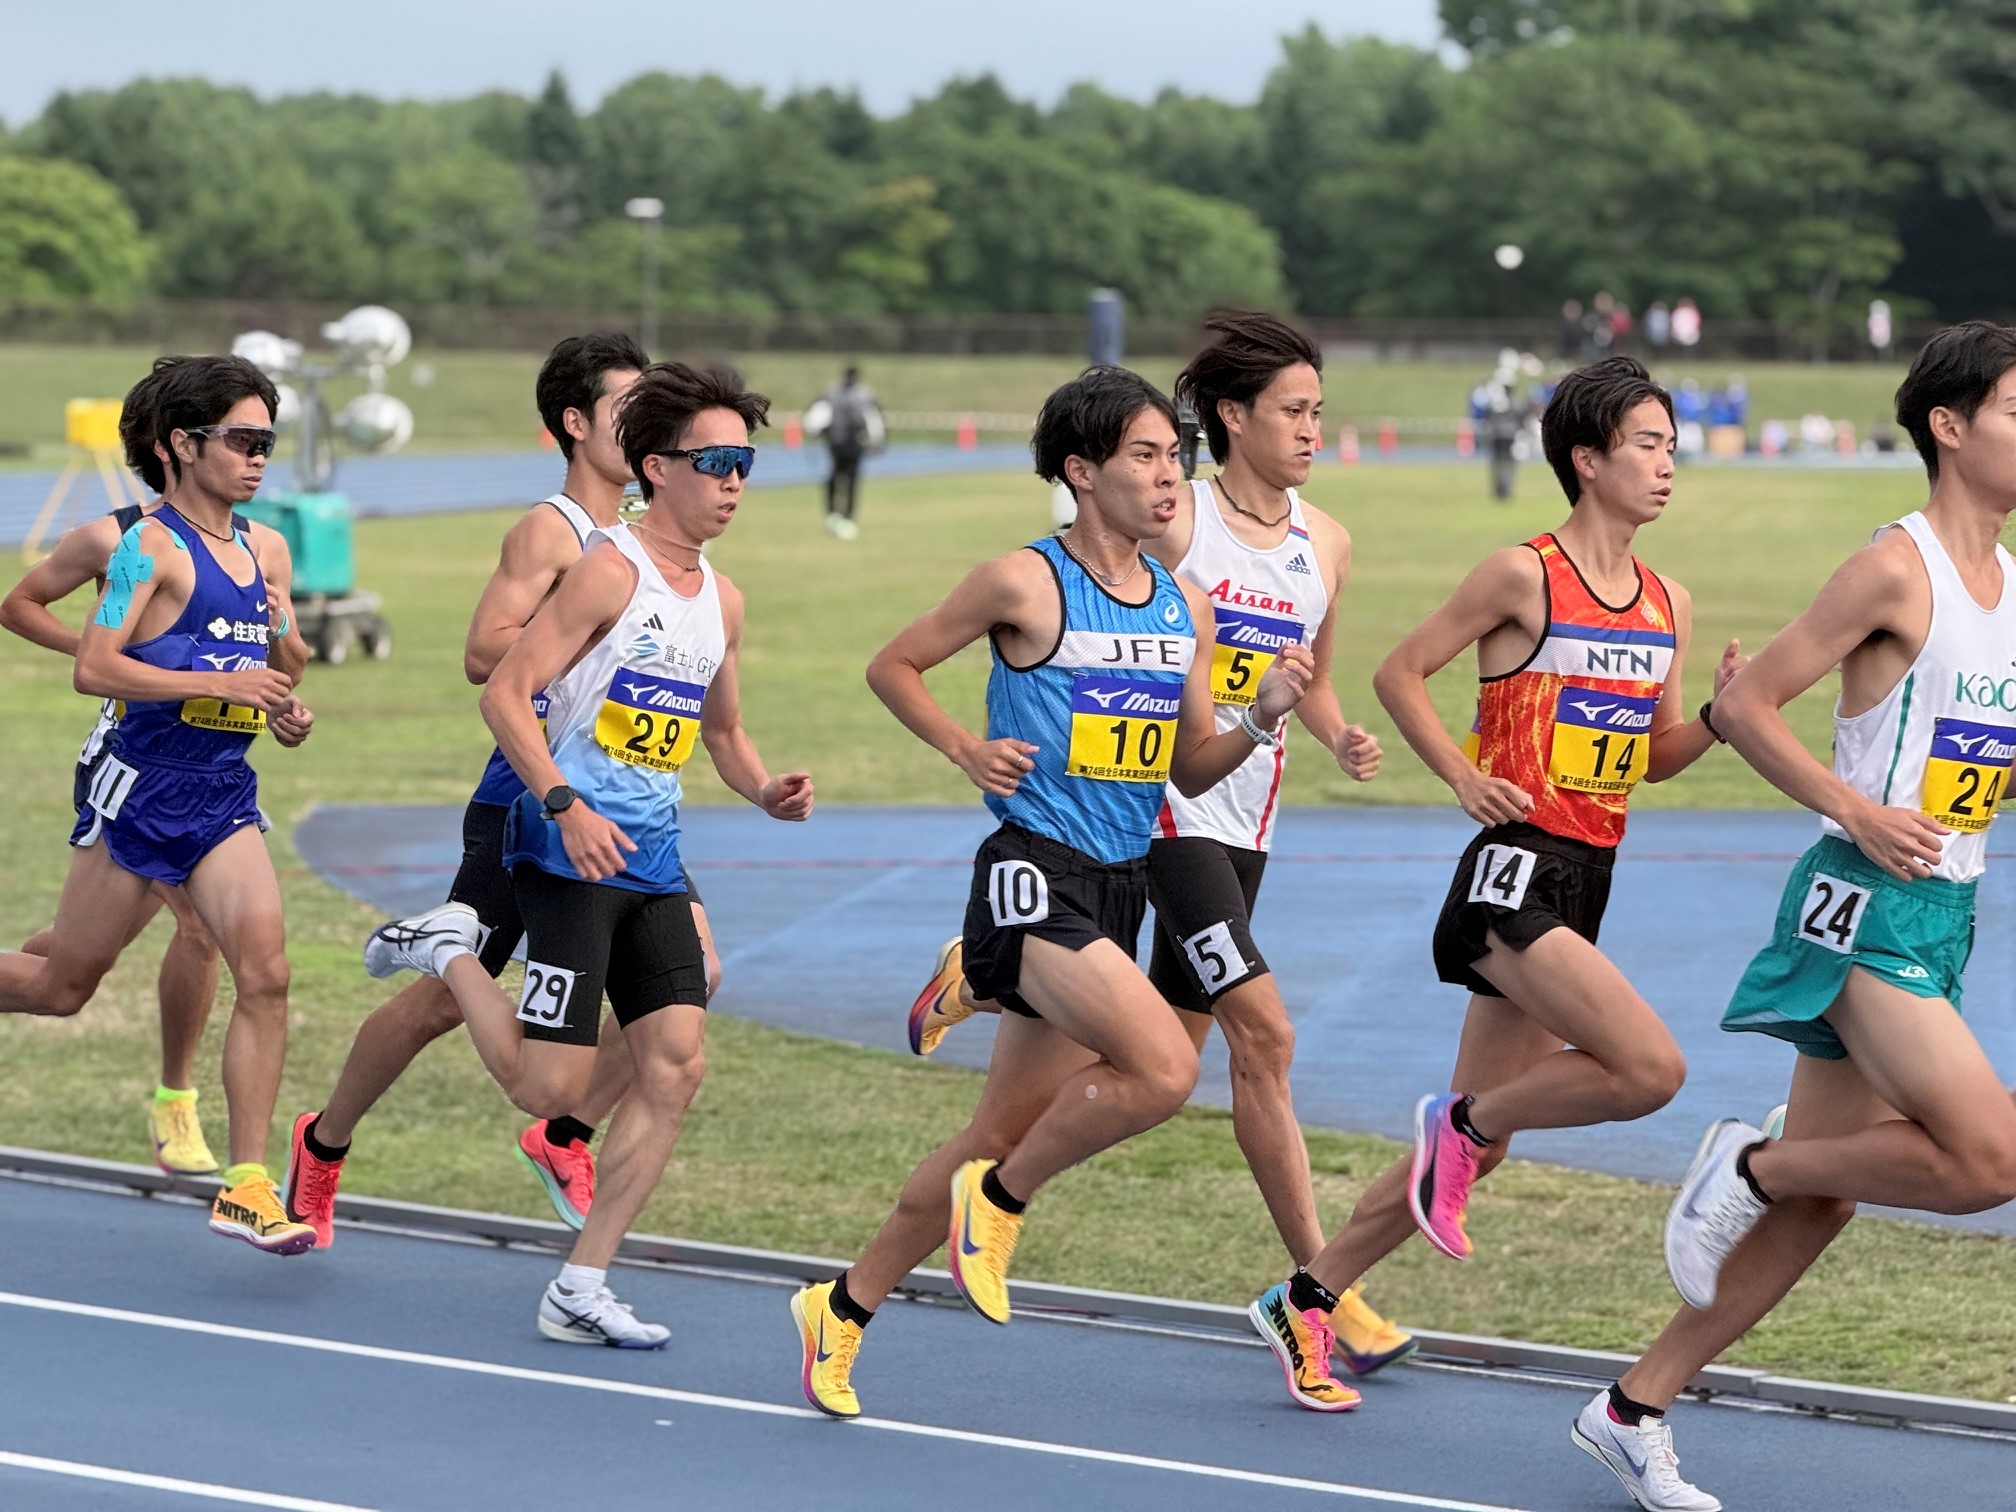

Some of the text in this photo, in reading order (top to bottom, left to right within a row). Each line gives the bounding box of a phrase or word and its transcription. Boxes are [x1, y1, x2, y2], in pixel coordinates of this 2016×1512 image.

[1285, 563, 1312, 576] adidas
[1208, 579, 1300, 617] Aisan
[1102, 639, 1181, 666] JFE
[1226, 651, 1254, 691] 5
[1586, 646, 1652, 676] NTN
[625, 712, 681, 758] 29
[1110, 720, 1162, 768] 10
[1592, 734, 1637, 780] 14
[93, 760, 127, 811] 11
[1948, 767, 2002, 818] 24
[998, 866, 1038, 919] 10
[1476, 848, 1524, 901] 14
[1804, 881, 1863, 946] 24
[1193, 934, 1227, 983] 5
[521, 968, 568, 1021] 29
[216, 1195, 258, 1227] NITRO
[1265, 1290, 1304, 1371] NITRO
